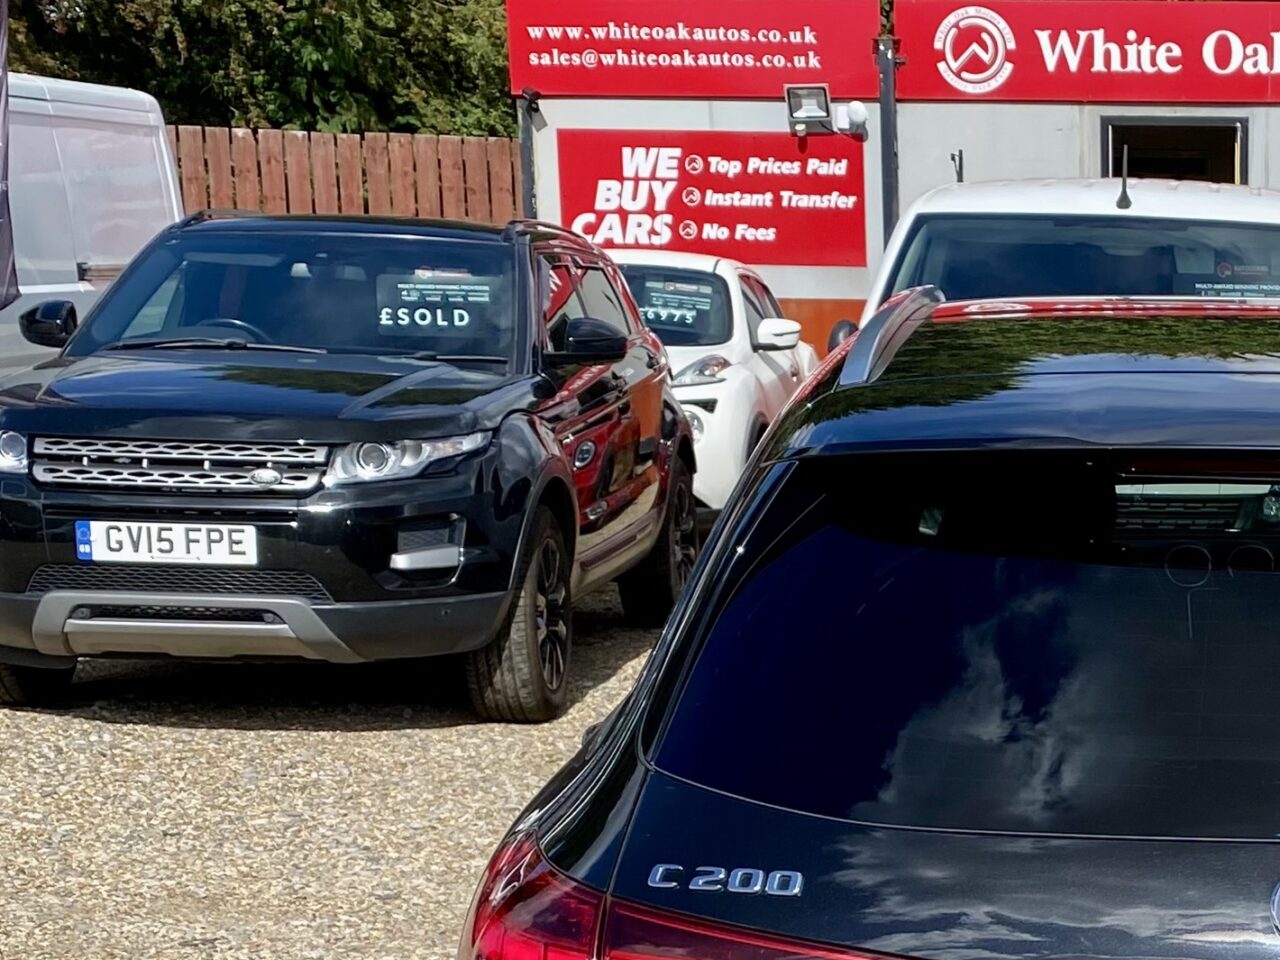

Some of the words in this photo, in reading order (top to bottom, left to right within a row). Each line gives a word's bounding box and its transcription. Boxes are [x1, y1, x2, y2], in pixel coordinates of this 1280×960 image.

[527, 22, 816, 43] www.whiteoakautos.co.uk
[530, 49, 820, 68] sales@whiteoakautos.co.uk
[1035, 29, 1182, 73] White
[622, 147, 681, 179] WE
[708, 157, 741, 177] Top
[747, 158, 801, 174] Prices
[807, 159, 847, 175] Paid
[595, 180, 677, 211] BUY
[705, 190, 773, 206] Instant
[780, 191, 856, 208] Transfer
[571, 212, 673, 246] CARS
[702, 224, 729, 239] No
[735, 224, 776, 240] Fees
[379, 307, 470, 326] £SOLD
[105, 525, 174, 554] GV15
[184, 527, 246, 556] FPE
[648, 863, 684, 889] C
[688, 866, 803, 897] 200
